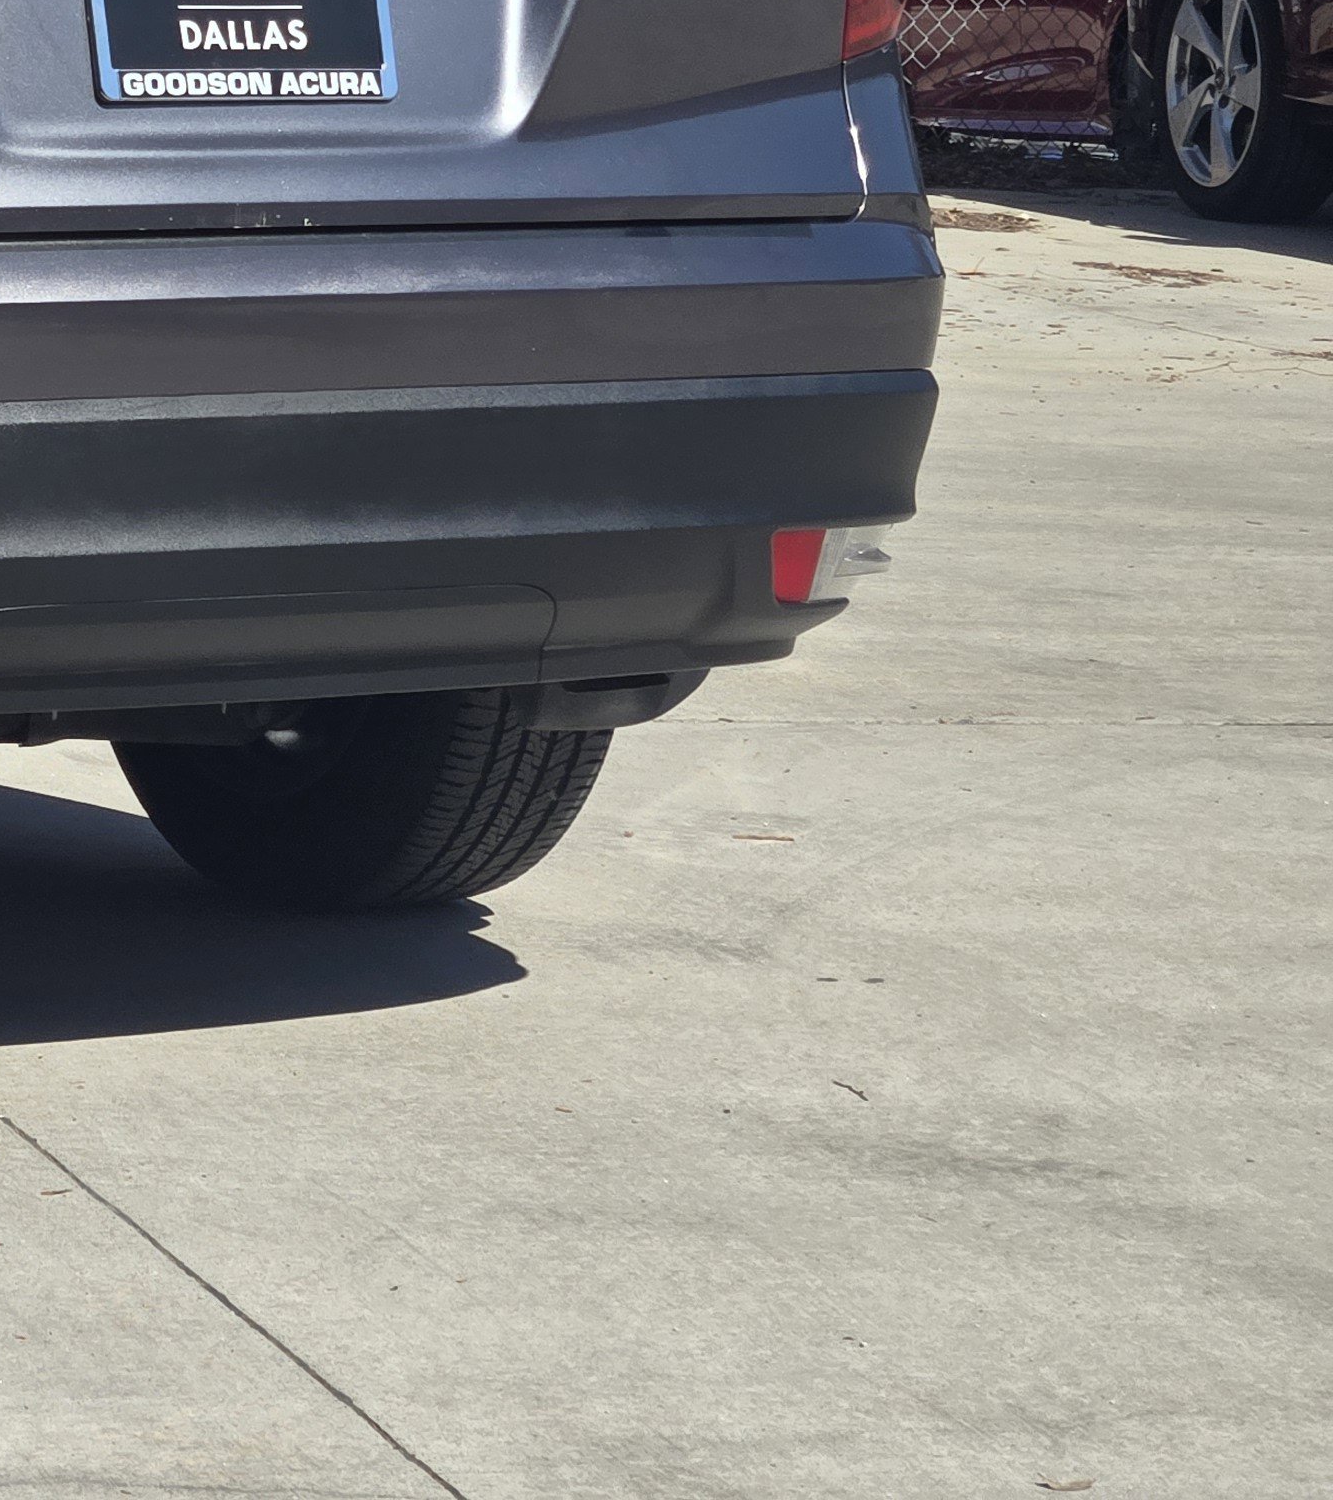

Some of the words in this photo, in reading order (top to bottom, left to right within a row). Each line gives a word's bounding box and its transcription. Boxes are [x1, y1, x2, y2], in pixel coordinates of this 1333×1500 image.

[178, 19, 308, 51] DALLAS
[122, 72, 273, 97] GOODSON
[279, 71, 381, 96] ACURA
